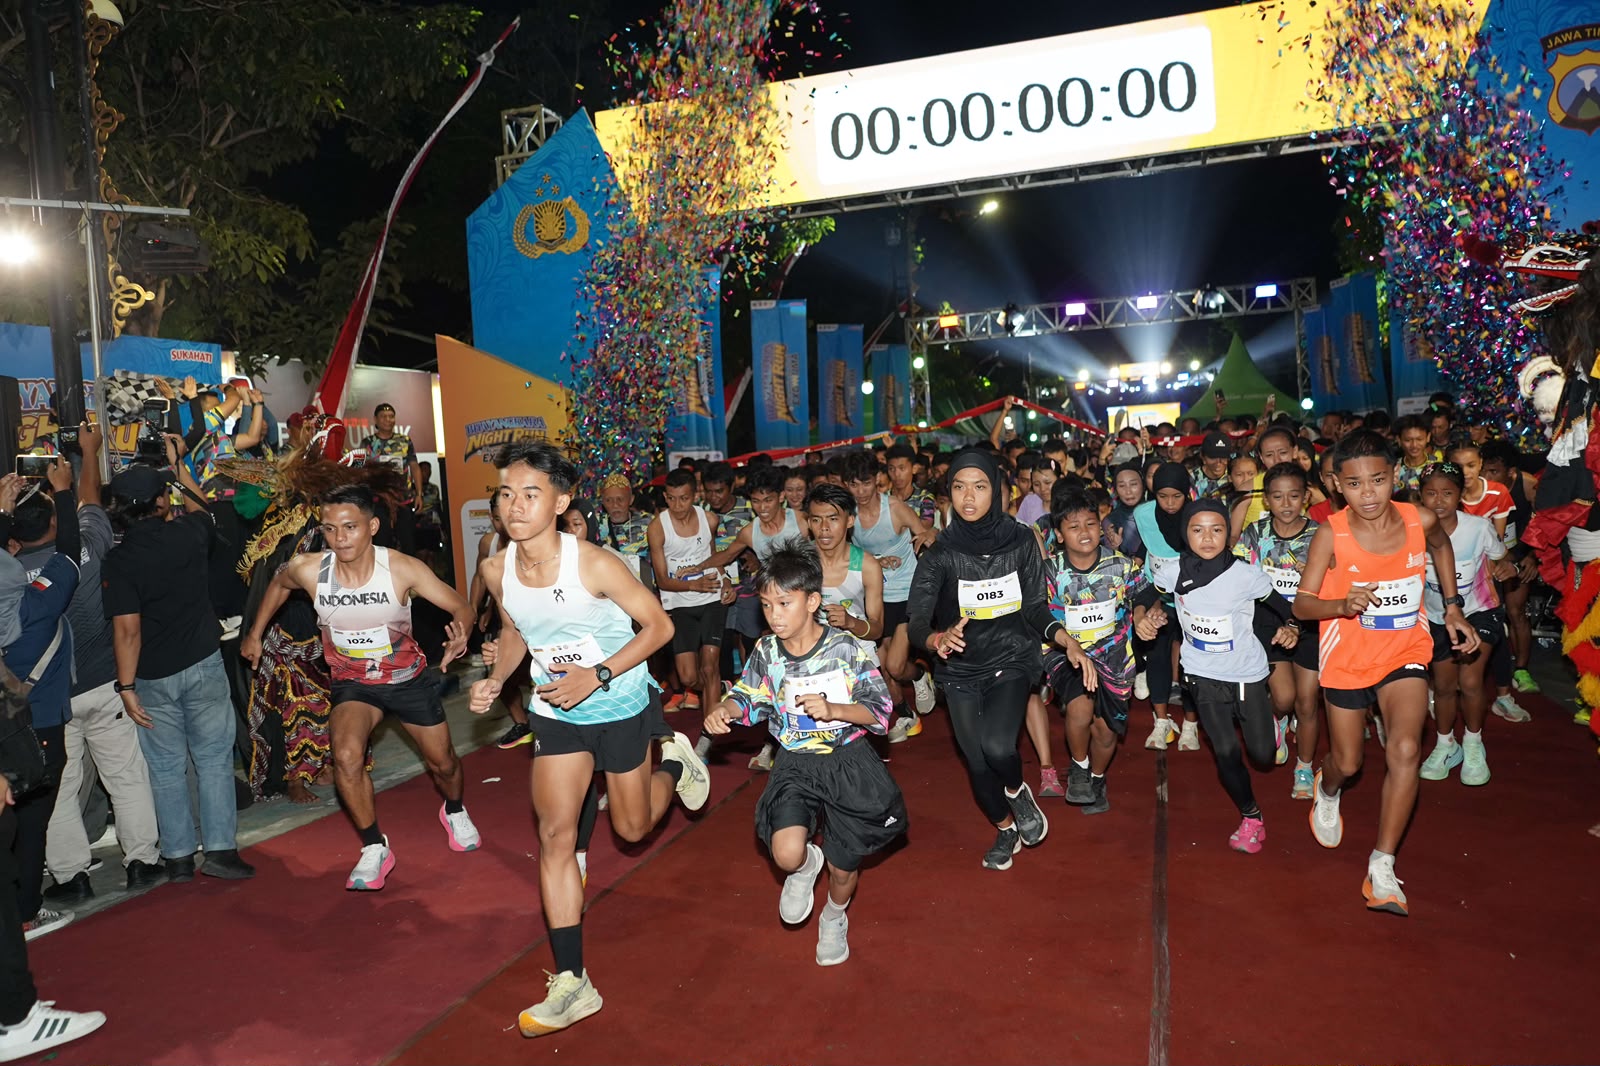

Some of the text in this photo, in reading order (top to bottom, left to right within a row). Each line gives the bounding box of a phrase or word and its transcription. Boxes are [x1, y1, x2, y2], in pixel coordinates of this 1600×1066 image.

[1547, 30, 1582, 49] JAWA
[831, 61, 1197, 161] 00:00:00:00
[170, 349, 213, 364] SUKAHATI
[466, 429, 513, 454] NIGHT
[1276, 580, 1299, 588] 0174
[319, 592, 391, 607] INDONESIA
[976, 590, 1004, 601] 0183
[1081, 614, 1104, 624] 0114
[1362, 618, 1376, 626] 5K
[1190, 623, 1219, 636] 0084
[552, 653, 582, 664] 0130
